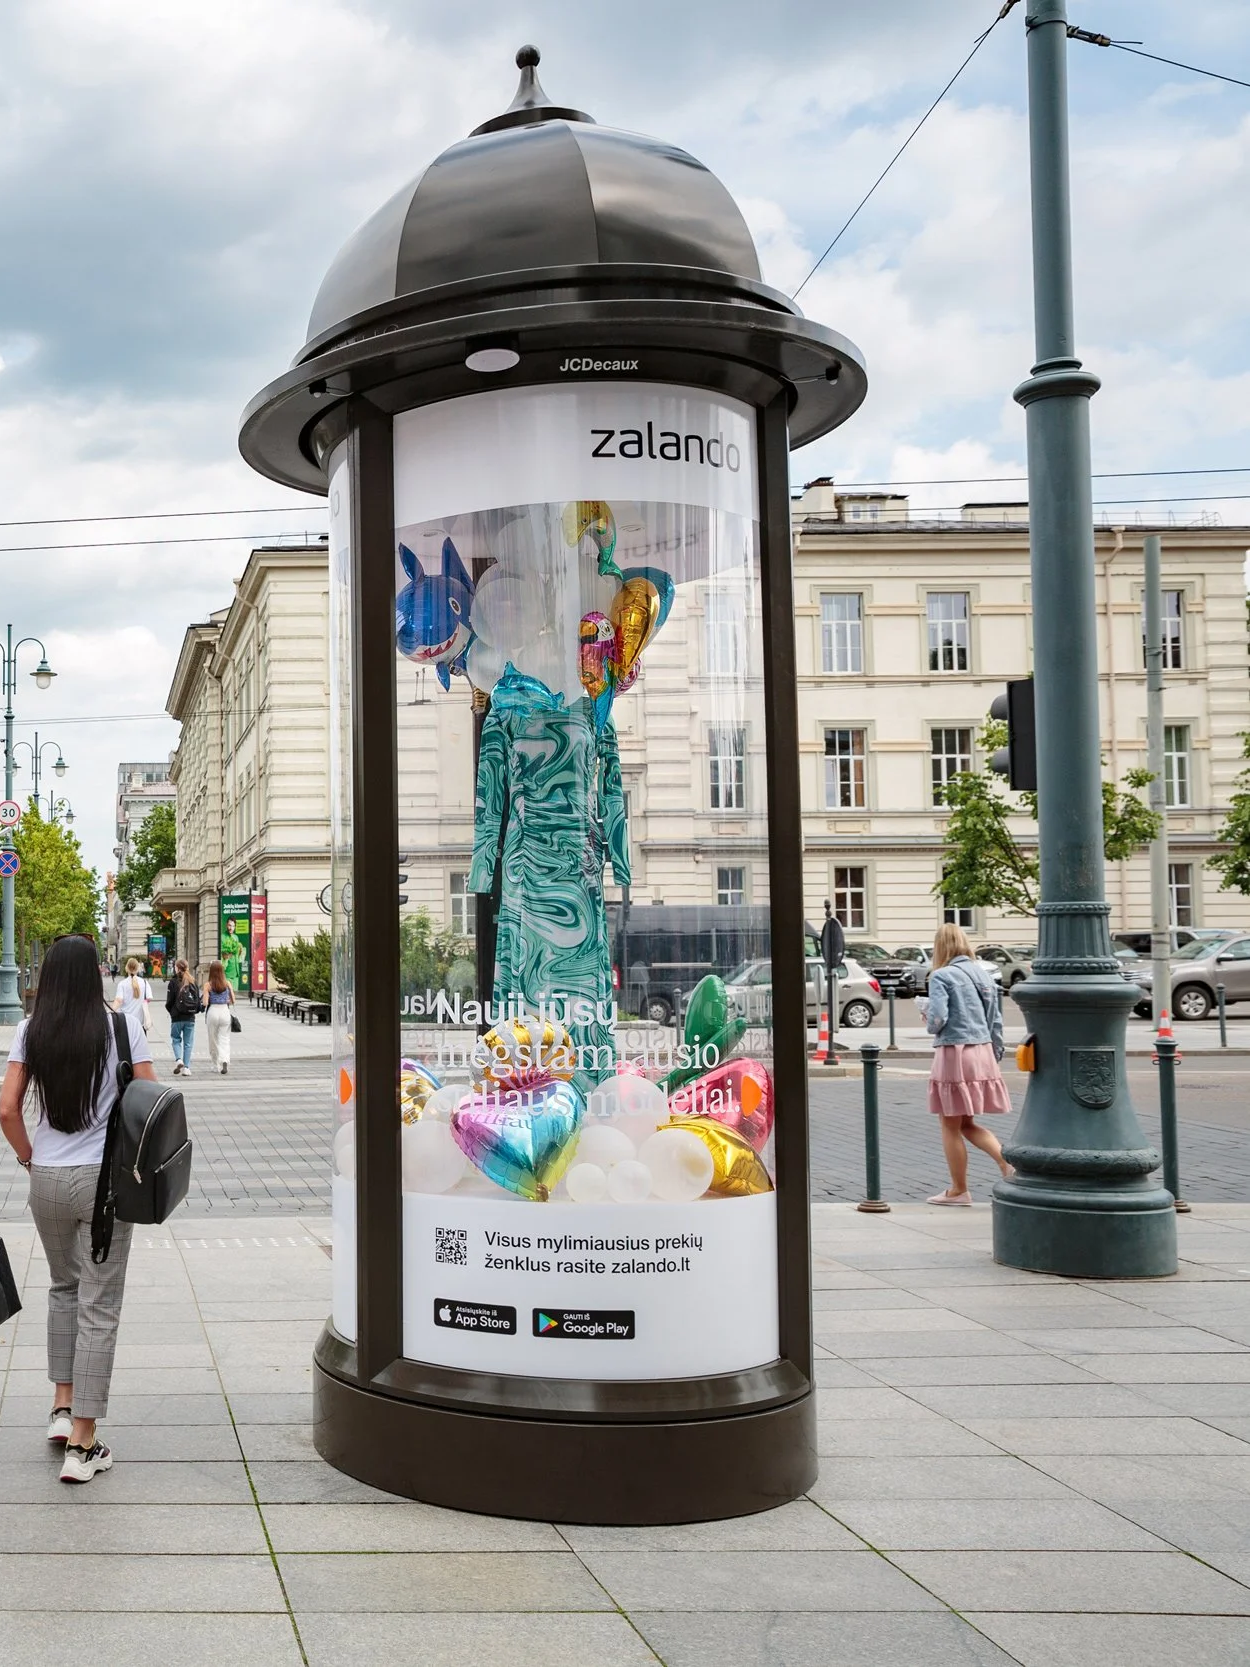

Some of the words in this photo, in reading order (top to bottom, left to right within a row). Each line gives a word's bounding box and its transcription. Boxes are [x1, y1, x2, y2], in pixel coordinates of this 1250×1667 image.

[559, 358, 639, 372] JCDecaux
[591, 421, 741, 473] zalando
[2, 808, 15, 818] 30
[436, 1034, 720, 1079] mėgstamiausio
[484, 1231, 531, 1248] Visus
[537, 1234, 650, 1253] mylimiausius
[655, 1233, 703, 1253] prekių
[484, 1253, 551, 1273] ženklus
[556, 1258, 606, 1274] rasite
[611, 1257, 691, 1274] zalando.lt
[455, 1306, 491, 1316] Atsisiųskite
[491, 1308, 498, 1317] iš
[563, 1313, 584, 1321] GAUTI
[584, 1312, 591, 1321] IŠ
[455, 1313, 479, 1328] App
[480, 1315, 511, 1329] Store
[563, 1321, 605, 1336] Google
[606, 1322, 630, 1336] Play
